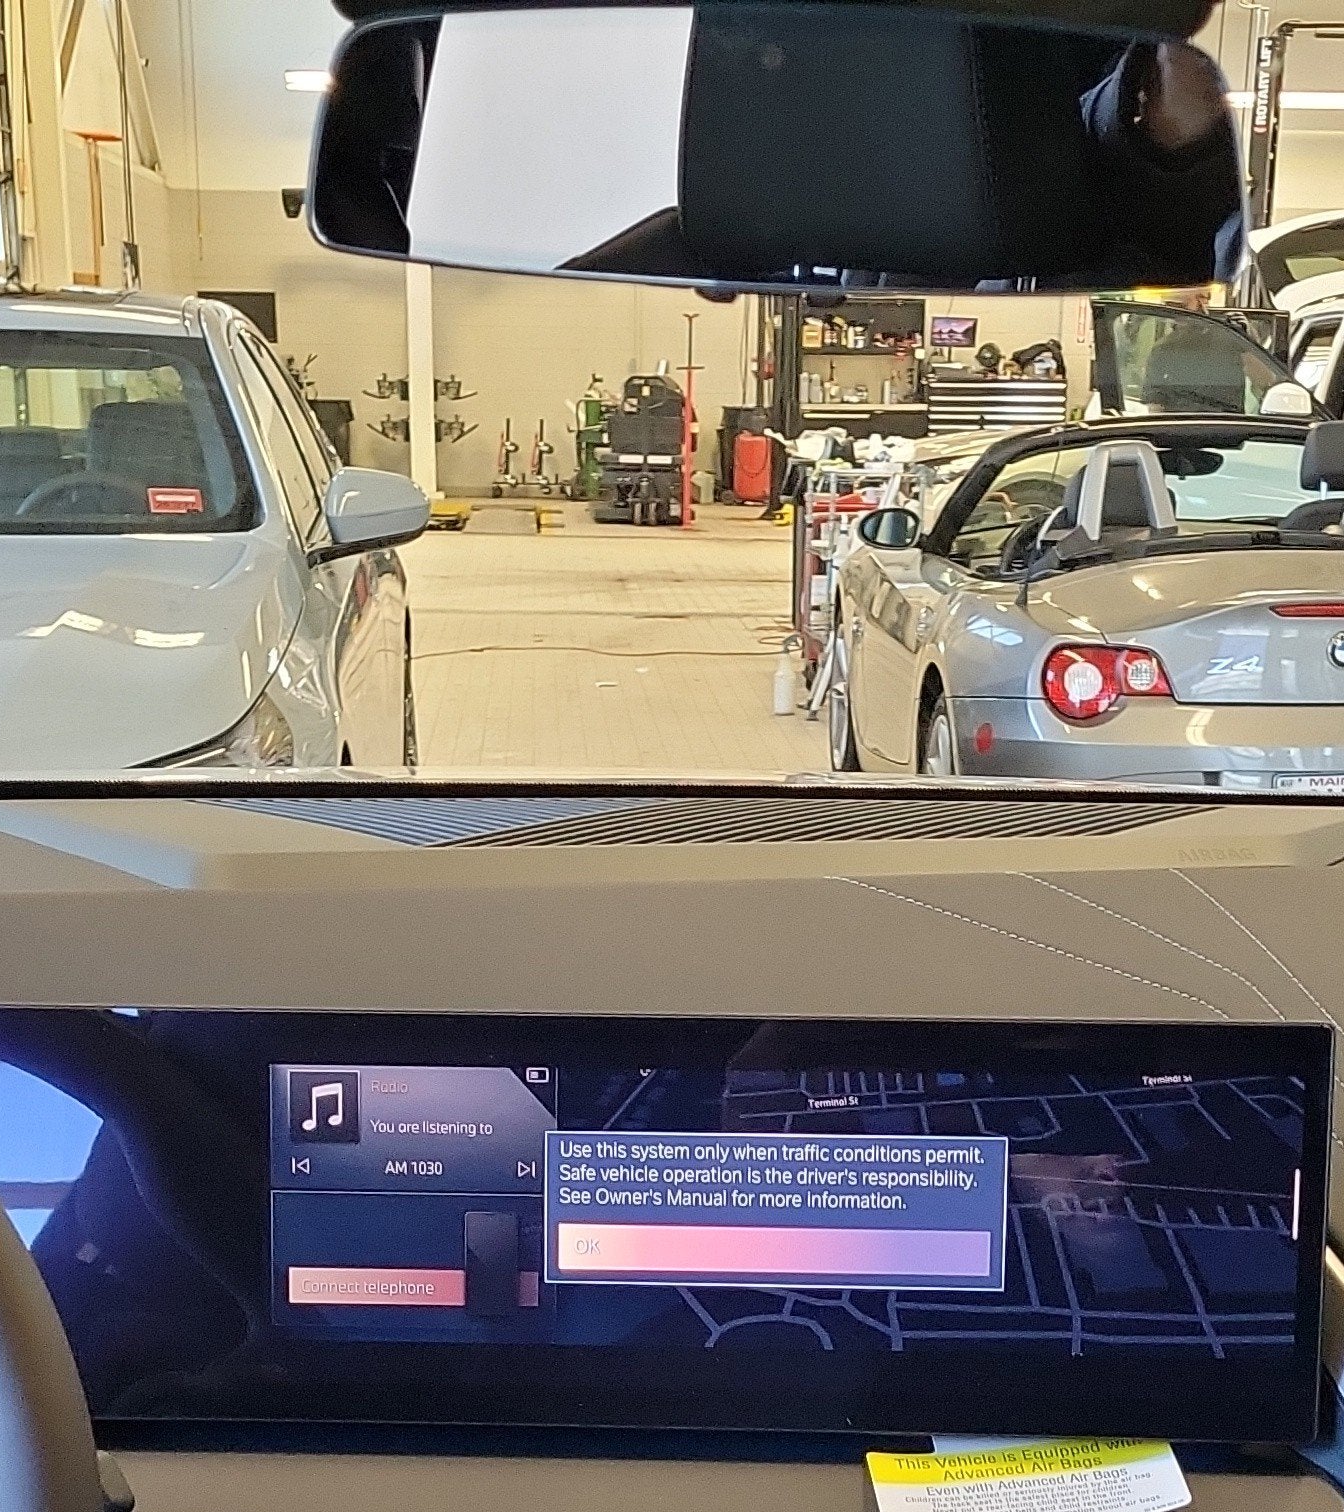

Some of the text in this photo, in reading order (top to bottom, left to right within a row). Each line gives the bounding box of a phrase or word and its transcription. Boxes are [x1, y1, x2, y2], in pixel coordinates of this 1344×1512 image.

[1255, 39, 1273, 125] ROTARY LIFT
[1207, 656, 1263, 674] Z4
[371, 1081, 409, 1094] Radio
[808, 1096, 859, 1108] Terminal St
[370, 1119, 493, 1137] You are listening to
[560, 1141, 985, 1166] Use this system only when traffic conditions permit.
[385, 1161, 443, 1175] AM 1030
[559, 1164, 978, 1191] Safe vehicle operation is the driver's responsibility.
[559, 1187, 907, 1210] See Owner's Manual for more information.
[575, 1239, 601, 1255] OK
[301, 1279, 435, 1297] Connect telephone
[894, 1458, 930, 1470] This
[935, 1454, 996, 1468] Vehicle
[1002, 1452, 1016, 1463] is
[1022, 1440, 1101, 1461] Equipped
[943, 1456, 1103, 1481] Advanced Air Bags
[926, 1468, 1128, 1496] Even with Advanced Air Bags
[1015, 1487, 1054, 1496] seriously
[1057, 1484, 1088, 1493] injured
[1091, 1481, 1101, 1489] by
[1105, 1478, 1118, 1486] the
